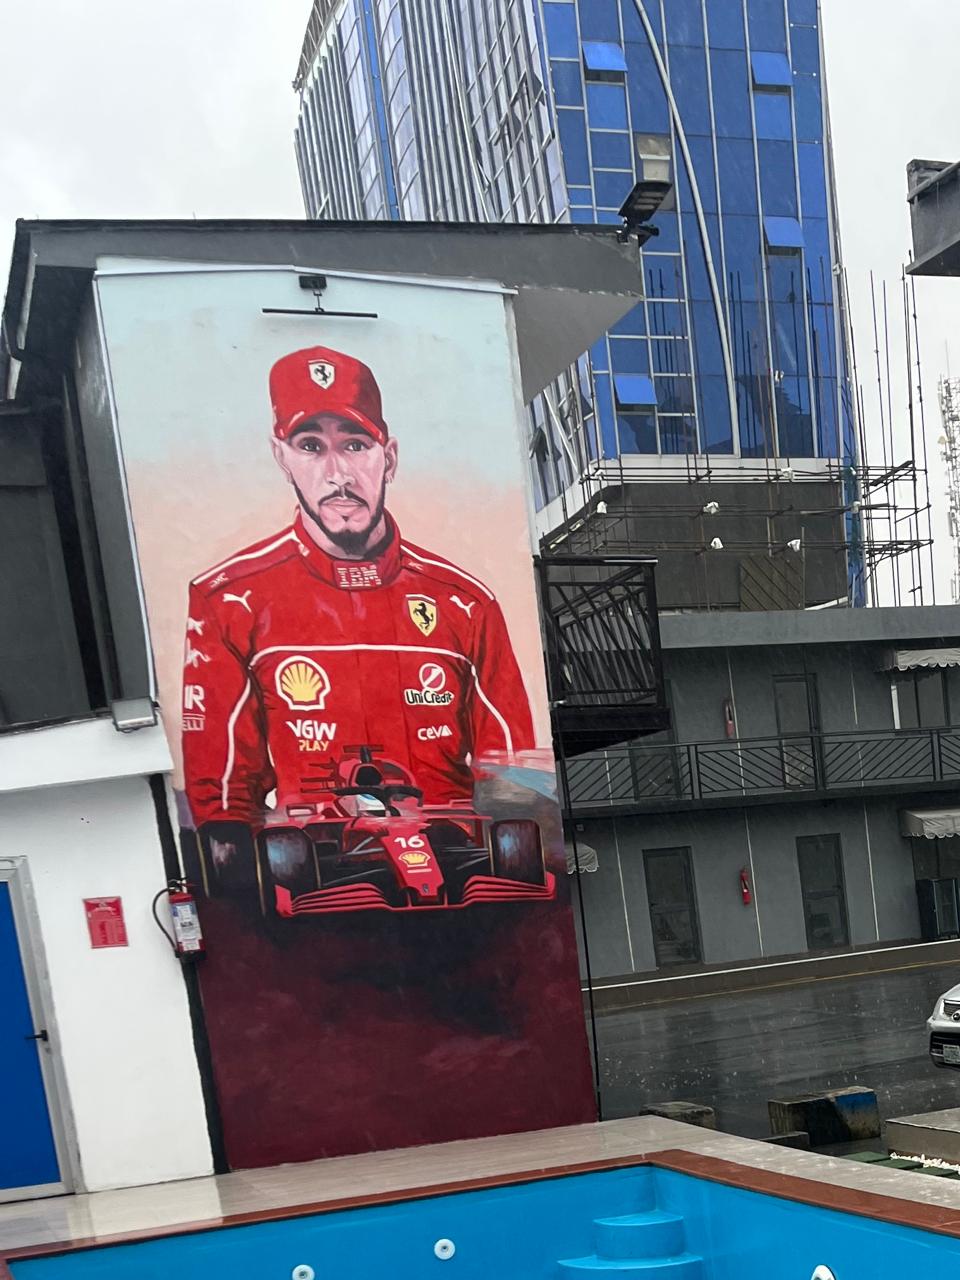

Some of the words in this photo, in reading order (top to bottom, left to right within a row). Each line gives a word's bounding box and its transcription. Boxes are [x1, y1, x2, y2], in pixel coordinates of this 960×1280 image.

[405, 690, 453, 704] UniCredit
[285, 719, 337, 741] VGW
[298, 740, 330, 751] PLAY
[394, 835, 425, 848] 16
